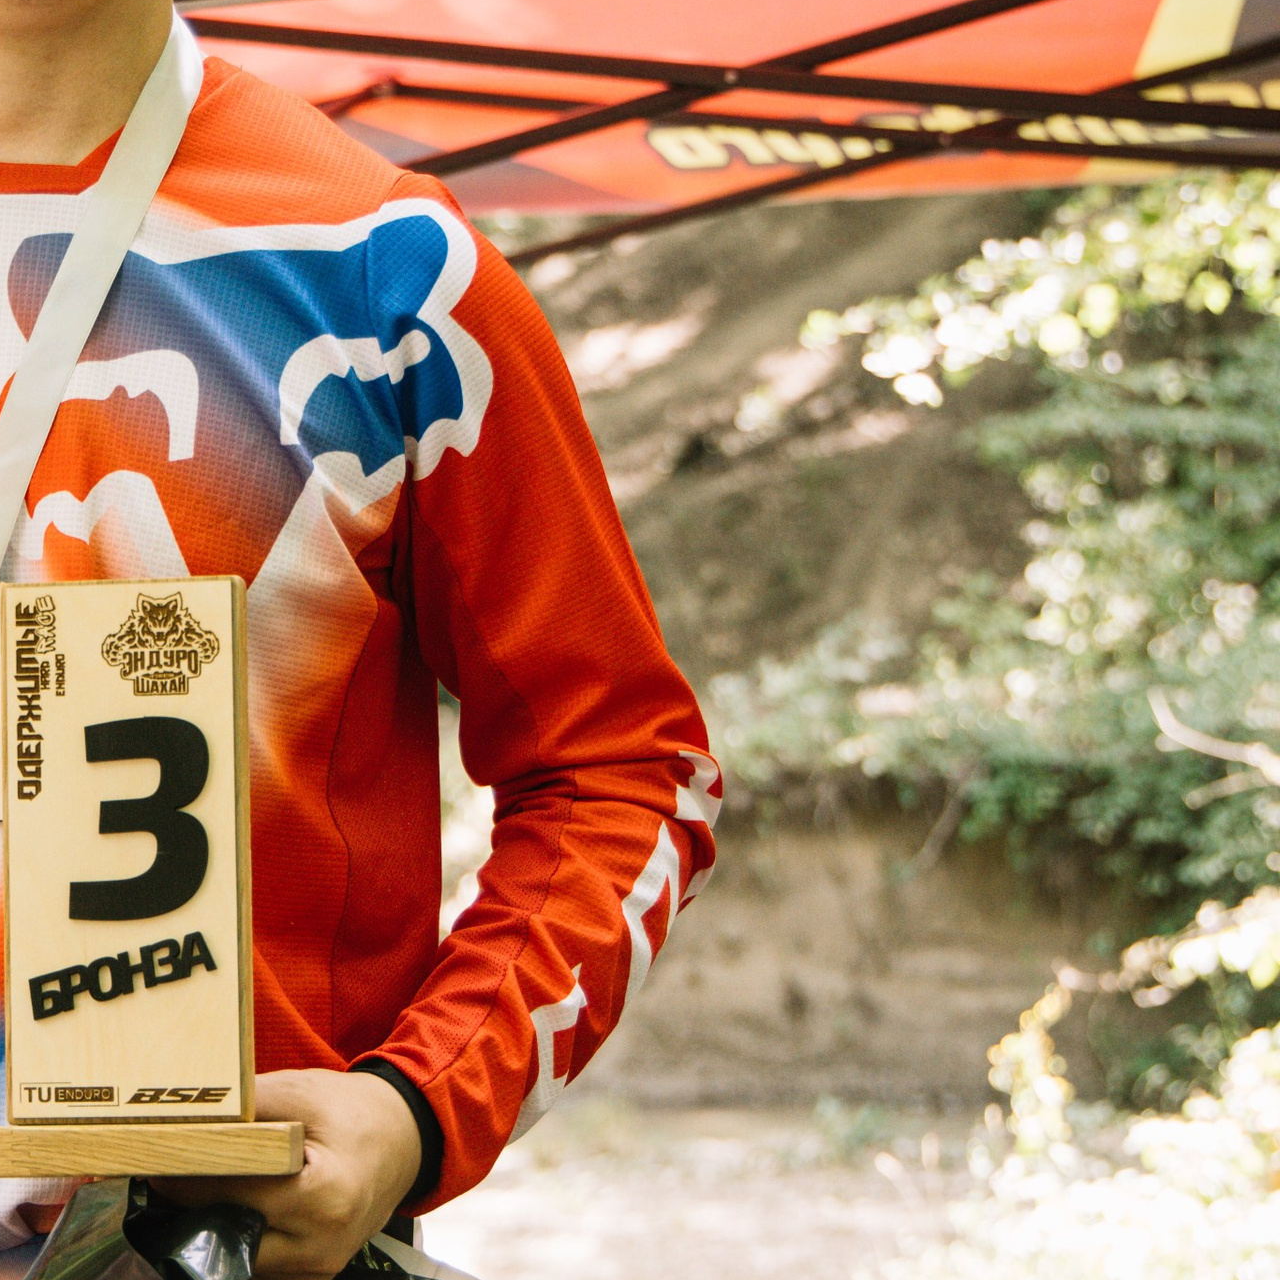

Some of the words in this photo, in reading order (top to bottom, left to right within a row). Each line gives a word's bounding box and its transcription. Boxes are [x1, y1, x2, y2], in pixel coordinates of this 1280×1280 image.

[40, 661, 50, 690] HARD
[55, 653, 65, 697] ENDURO
[122, 649, 199, 677] ЭНДУРО
[135, 674, 187, 694] ШАХАН
[69, 716, 211, 922] 3
[28, 931, 218, 1021] БРОНЗА
[24, 1087, 51, 1103] TU
[58, 1088, 111, 1101] ENDURO
[124, 1087, 232, 1105] BSE
